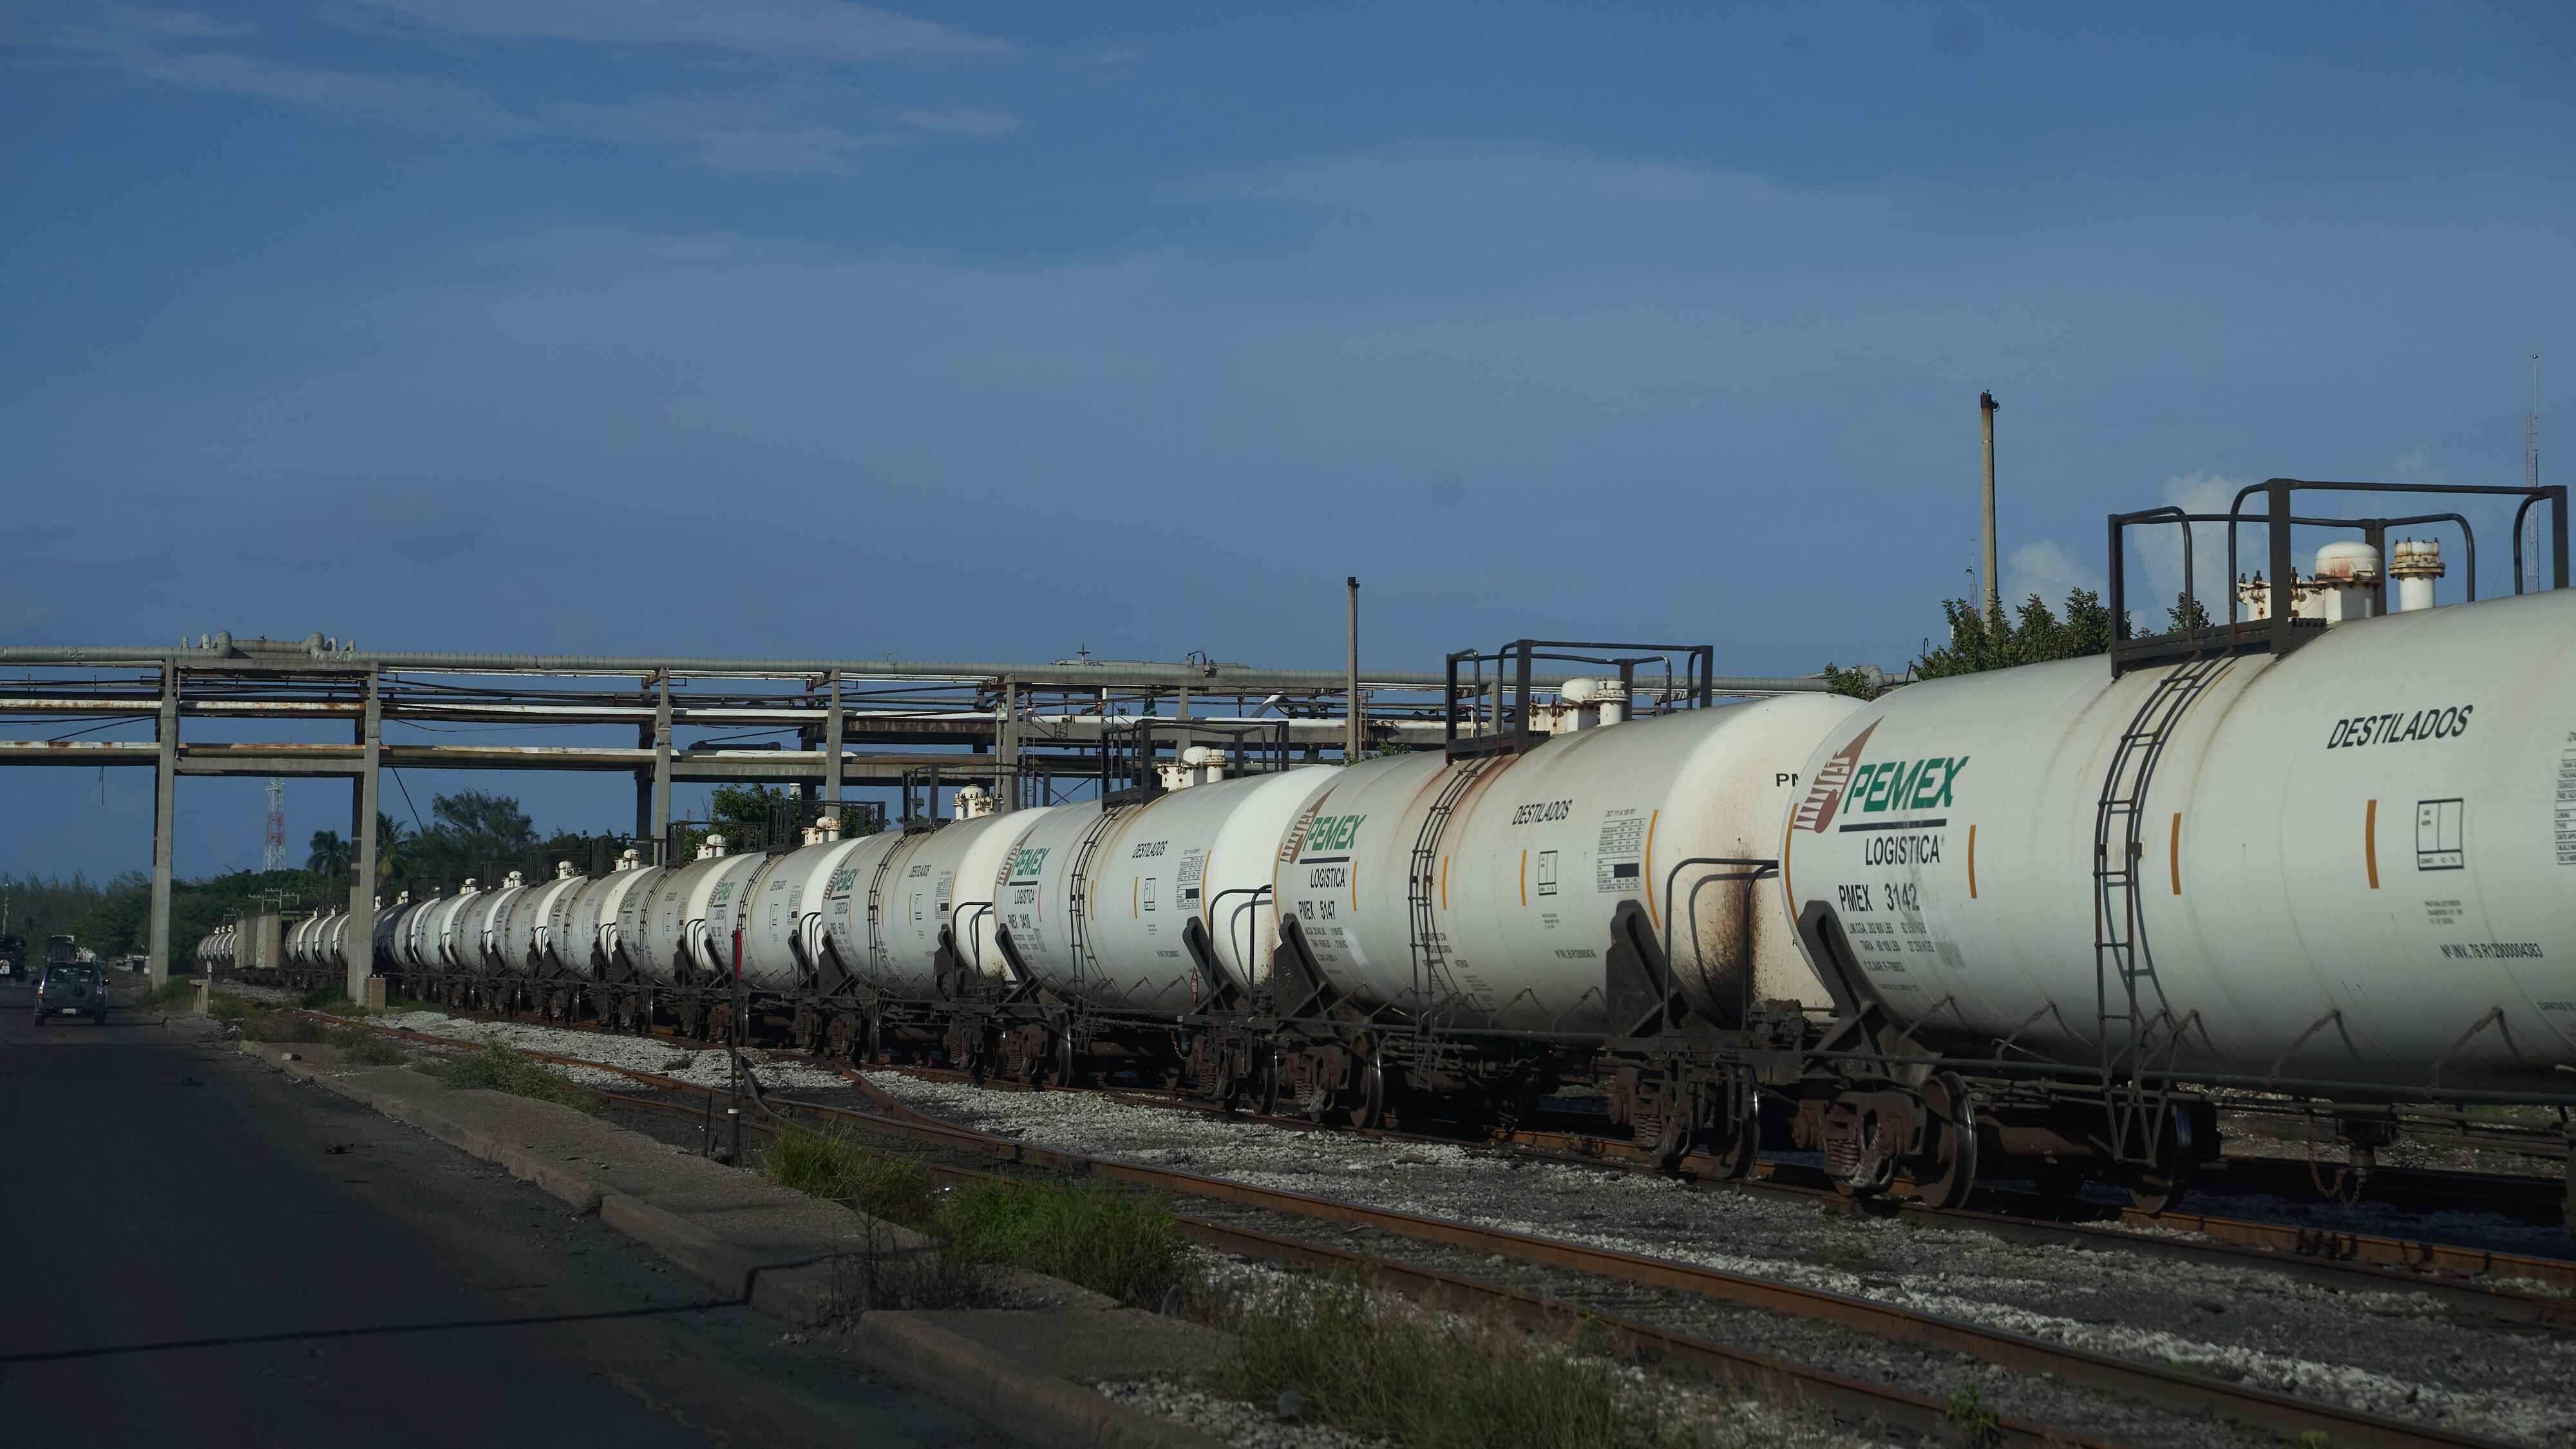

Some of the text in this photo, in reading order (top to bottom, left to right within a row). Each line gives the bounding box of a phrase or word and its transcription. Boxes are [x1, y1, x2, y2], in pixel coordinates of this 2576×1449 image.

[2327, 705, 2474, 749] DESTILADOS
[1843, 756, 1970, 814] PEMEX
[1512, 799, 1573, 826] DESTILADOS
[1303, 814, 1367, 851] PEMEX
[1132, 840, 1168, 858] DESTILADOS
[1012, 848, 1050, 876] PEMEX
[833, 868, 860, 892] PEMEX
[1311, 867, 1345, 888] LOGISTICA
[1014, 889, 1035, 905] LOGISTICA
[1839, 883, 1920, 912] PMEX 3142
[1298, 900, 1336, 920] PMEX 5147
[1008, 914, 1018, 929] PMEX
[1884, 922, 1893, 934] LBS
[1860, 941, 1875, 952] TARA
[1889, 941, 1900, 952] LBS
[2468, 943, 2483, 958] 76
